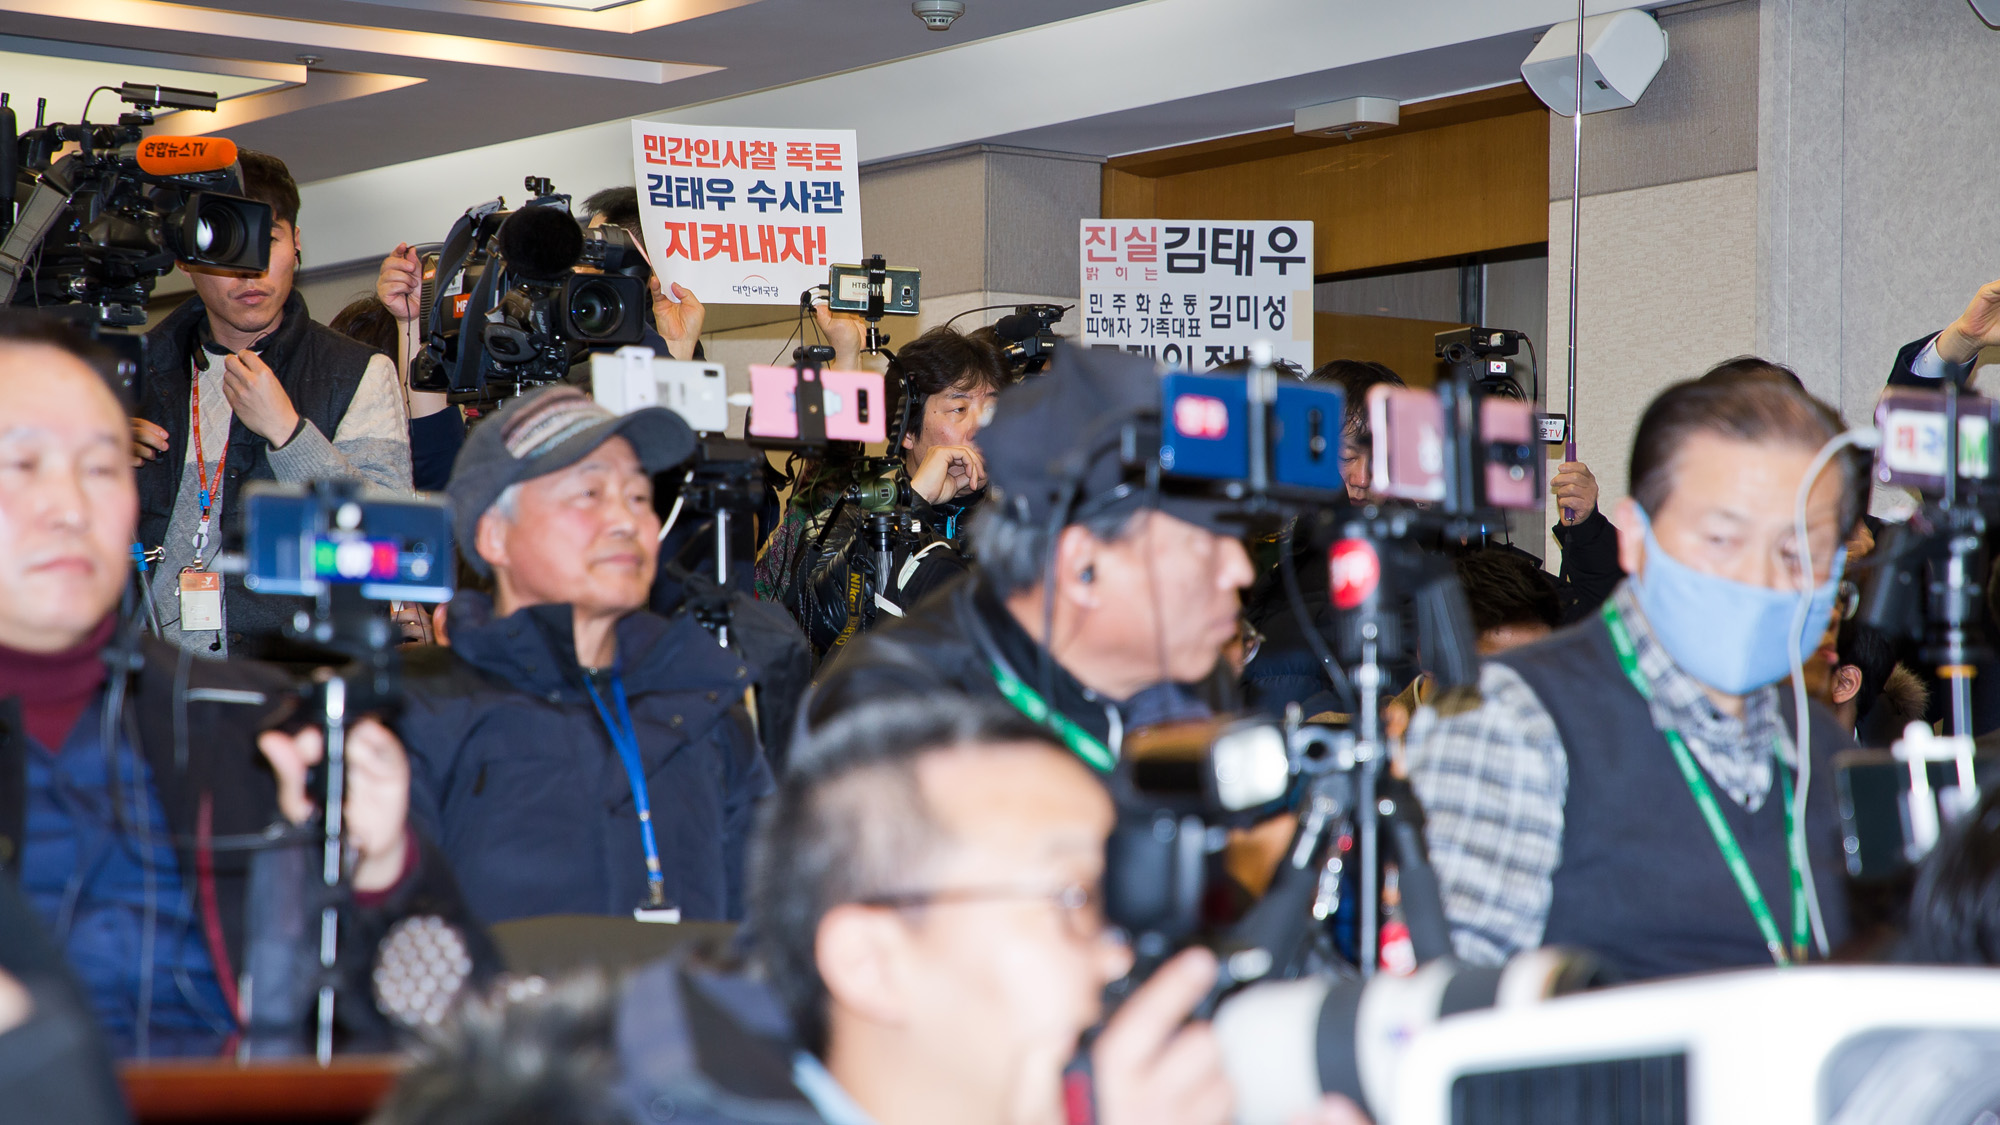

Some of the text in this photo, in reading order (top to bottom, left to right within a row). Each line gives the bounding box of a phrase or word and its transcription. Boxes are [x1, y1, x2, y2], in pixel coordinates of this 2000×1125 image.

[145, 142, 208, 157] 연합뉴스TV
[643, 134, 843, 171] 민간인사찰 폭로
[646, 173, 845, 214] 김태우 수사관
[664, 221, 828, 266] 지켜내자!
[1085, 226, 1306, 276] 진실 김태우
[1086, 316, 1201, 338] 피해자 가족대표
[1209, 295, 1286, 331] 김미성
[849, 572, 861, 612] Nikon
